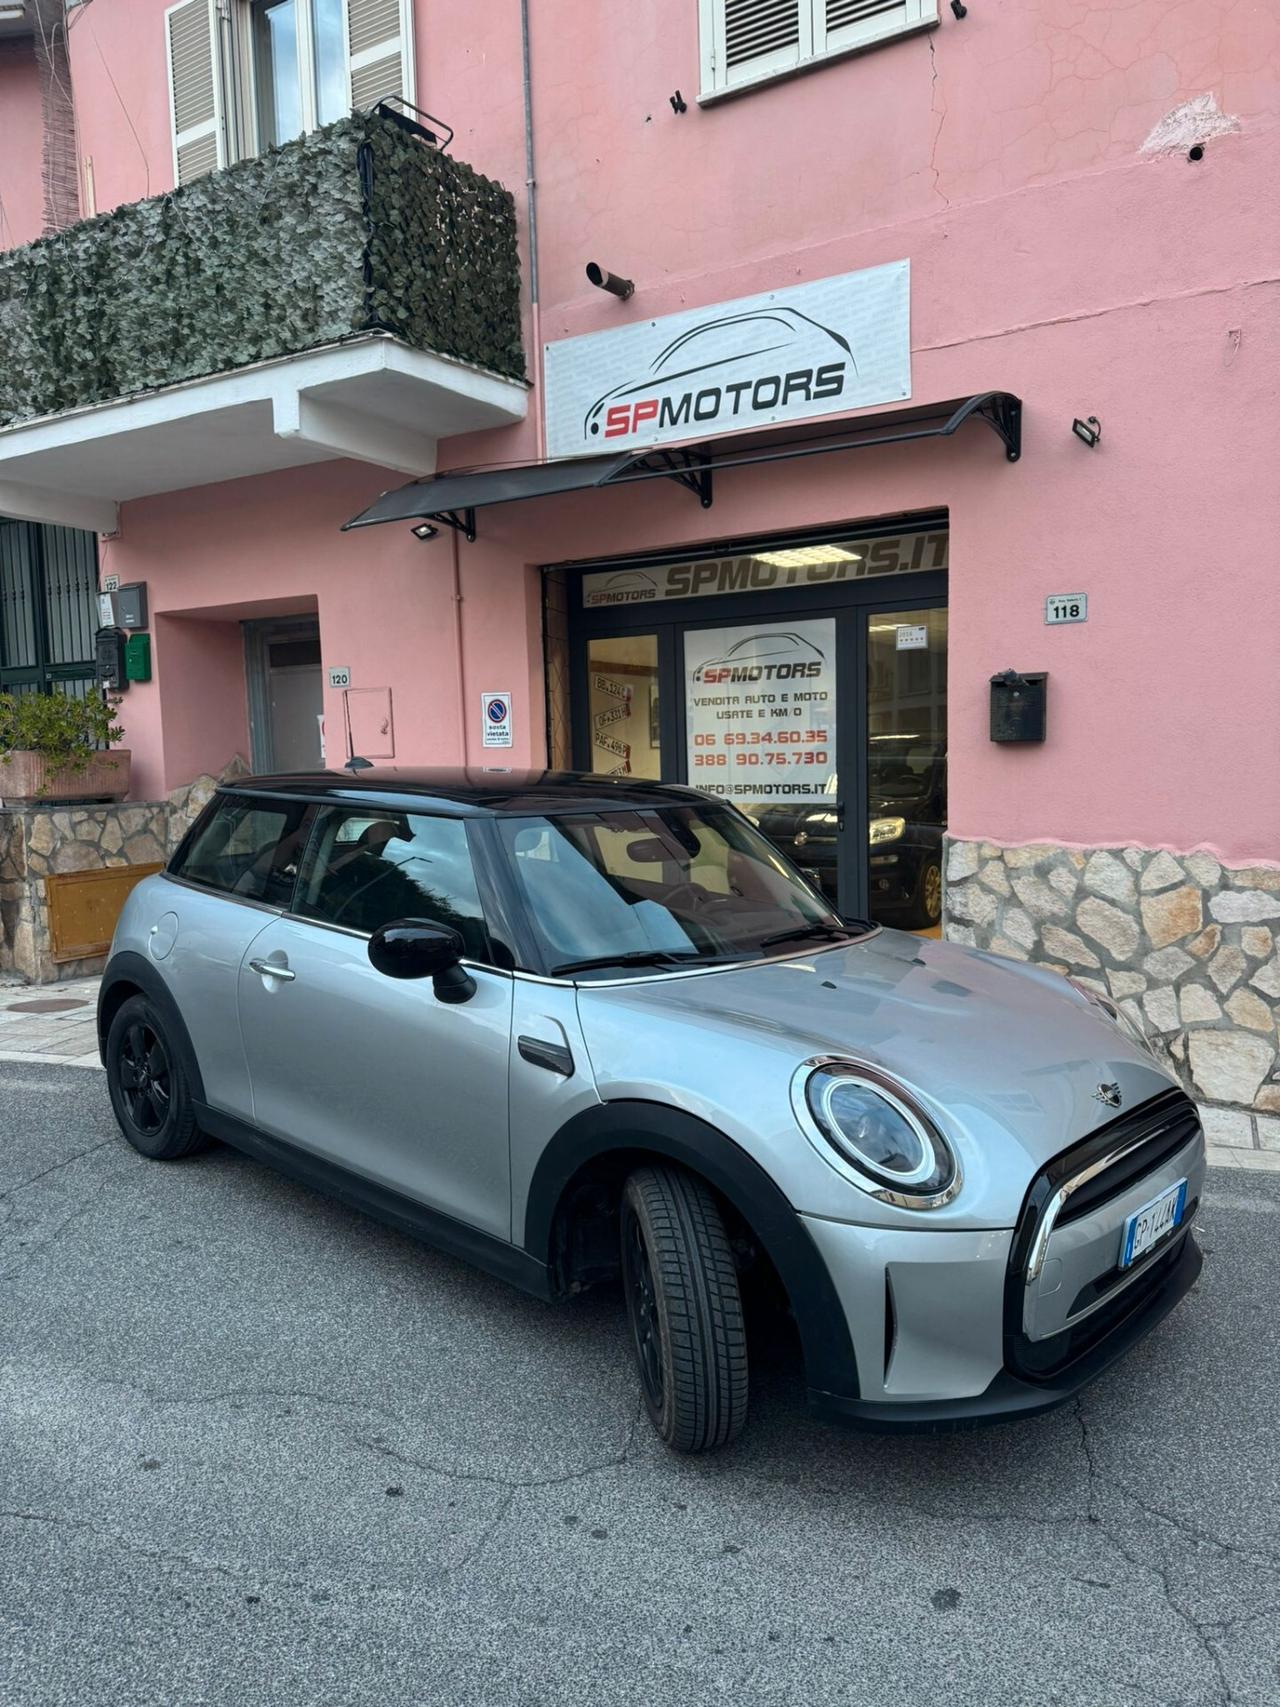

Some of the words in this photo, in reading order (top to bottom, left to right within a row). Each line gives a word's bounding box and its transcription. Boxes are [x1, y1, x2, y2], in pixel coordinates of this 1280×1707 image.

[604, 362, 846, 438] SPMOTORS
[591, 588, 656, 605] SPMOTORS
[1053, 604, 1080, 619] 118
[332, 674, 348, 684] 120
[703, 661, 822, 684] SPMOTORS
[694, 695, 740, 707] VENDITA
[745, 693, 776, 704] AUTO
[780, 692, 789, 703] E
[793, 691, 828, 702] MOTO
[716, 709, 753, 720] USATE
[757, 708, 766, 719] E
[694, 734, 716, 746] 06
[723, 730, 828, 745] 69.34.60.35
[694, 754, 727, 767] 388
[735, 751, 828, 766] 90.75.730
